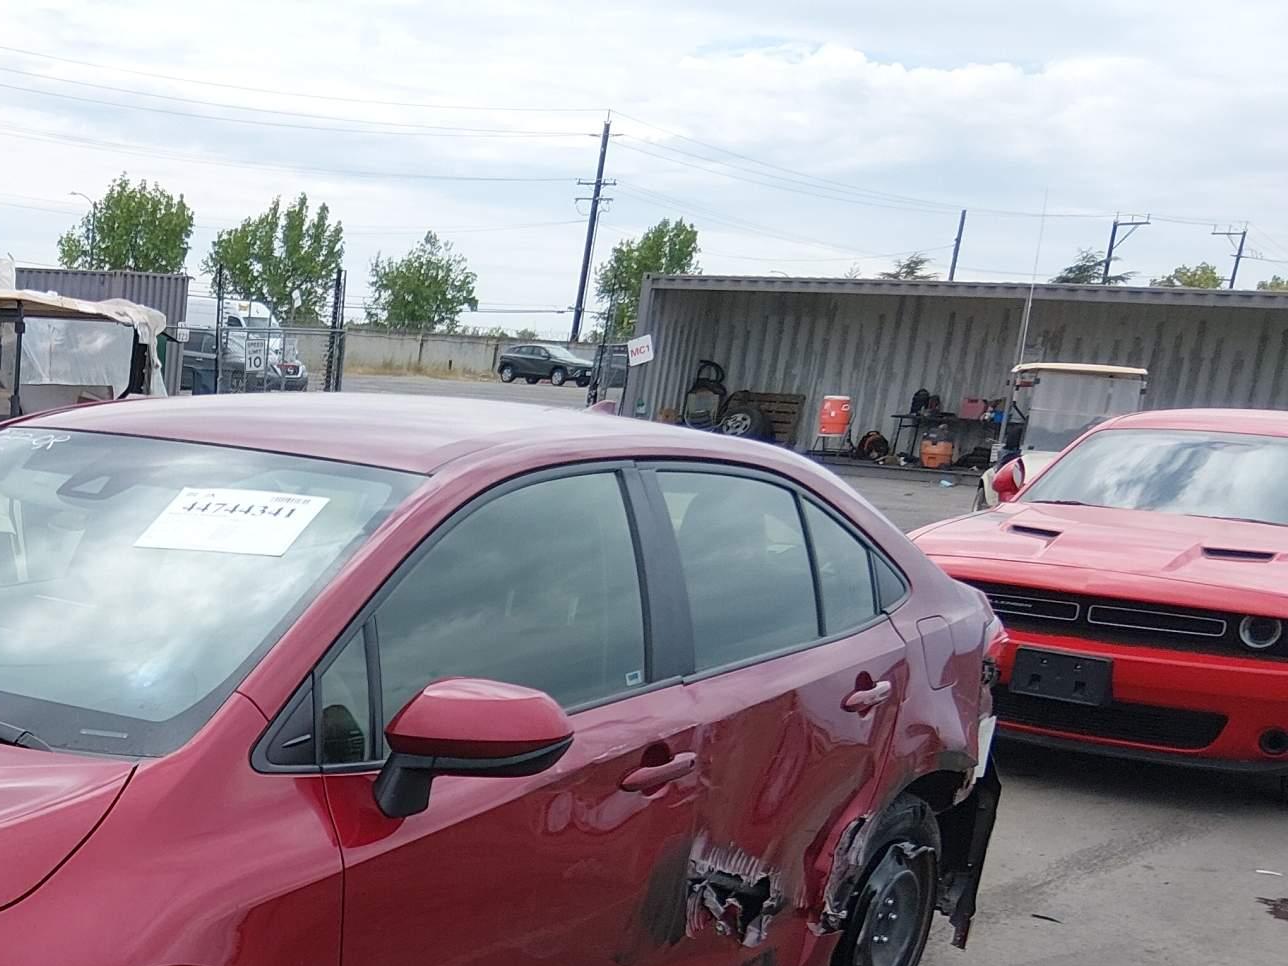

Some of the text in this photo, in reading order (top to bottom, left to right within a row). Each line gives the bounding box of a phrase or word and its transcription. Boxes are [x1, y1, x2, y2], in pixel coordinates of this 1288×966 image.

[631, 345, 650, 358] MC1
[249, 356, 262, 368] 10
[182, 502, 296, 518] 44744341
